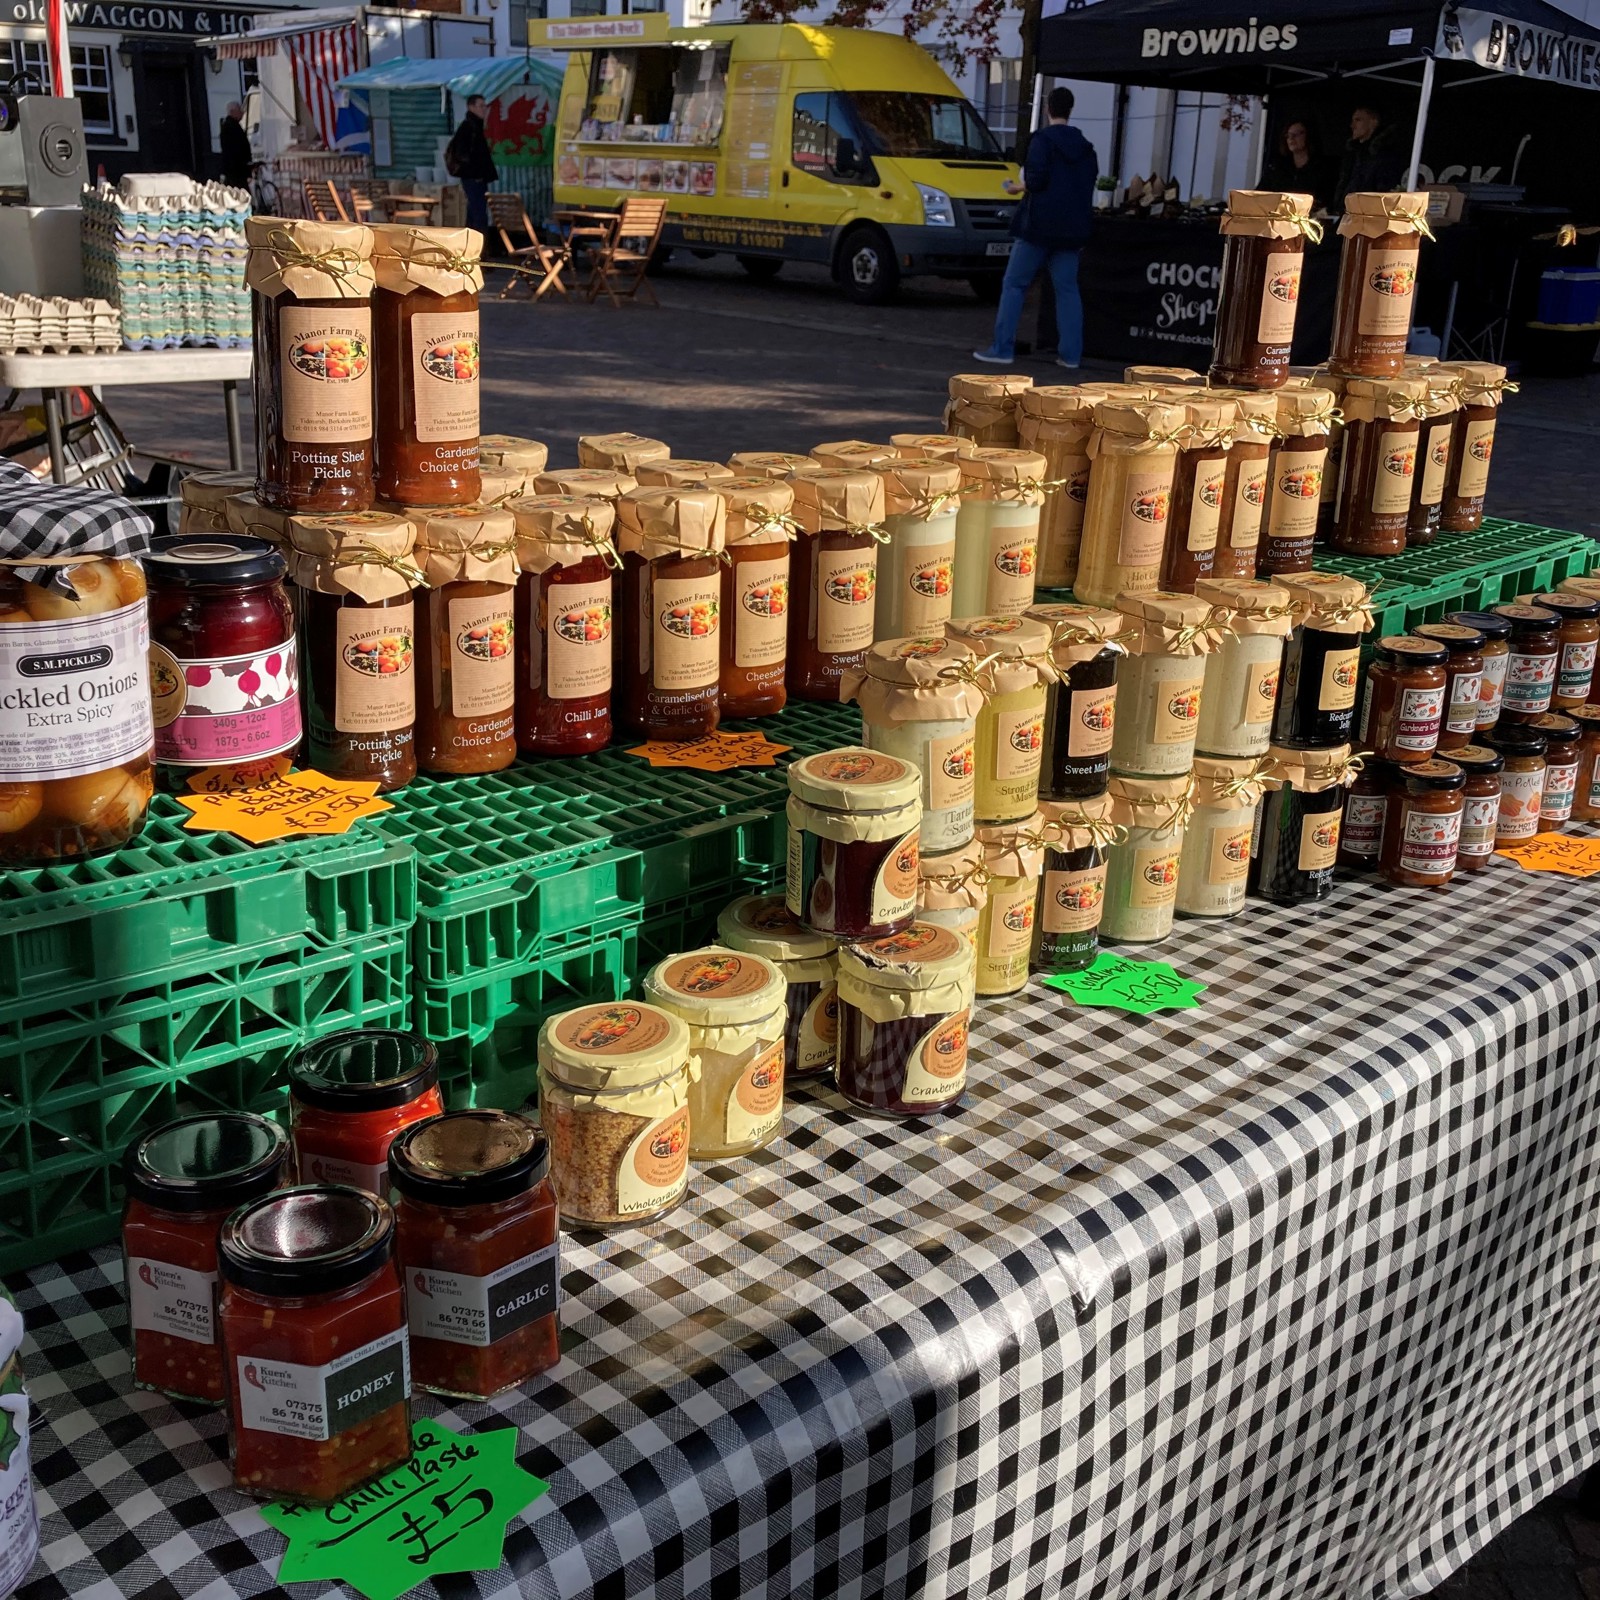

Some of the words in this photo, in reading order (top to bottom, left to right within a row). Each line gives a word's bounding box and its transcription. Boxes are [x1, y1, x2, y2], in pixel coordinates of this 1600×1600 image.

[64, 1, 184, 30] WAGGON
[195, 12, 211, 31] &
[1141, 17, 1298, 58] Brownies
[1156, 292, 1217, 328] Shop
[294, 328, 327, 343] Manor
[330, 326, 353, 337] Farm
[425, 333, 455, 348] Manor
[457, 330, 473, 339] Farm
[291, 450, 338, 465] Potting
[341, 449, 365, 463] Shed
[313, 466, 352, 479] Pickle
[419, 460, 459, 473] Choice
[1000, 540, 1022, 552] Manor
[1267, 548, 1292, 558] Onion
[829, 564, 854, 578] Manor
[855, 562, 870, 570] Farm
[915, 560, 938, 572] Manor
[747, 577, 772, 590] Manor
[773, 573, 786, 581] Farm
[558, 600, 586, 615] Manor
[588, 597, 604, 607] Farm
[665, 595, 693, 610] Manor
[694, 593, 711, 601] Farm
[461, 614, 490, 632] Manor
[492, 610, 508, 620] Farm
[349, 628, 381, 643] Manor
[383, 625, 402, 635] Farm
[33, 652, 102, 671] S.M.PICKLES
[831, 654, 860, 665] Sweet
[821, 666, 845, 676] Onio
[78, 671, 138, 702] Onions
[1172, 687, 1191, 699] Manor
[1505, 685, 1533, 698] Potting
[647, 689, 705, 704] Caramelised
[1086, 698, 1104, 709] Manor
[26, 711, 73, 728] Extra
[77, 703, 115, 723] Spicy
[564, 710, 592, 723] Chilli
[593, 706, 607, 719] Jam
[651, 705, 660, 715] &
[662, 704, 692, 716] Garlic
[213, 718, 237, 729] 340g
[245, 713, 267, 723] 12oz
[1014, 716, 1034, 730] Manor
[215, 736, 239, 748] 187g
[247, 729, 270, 742] 6.6oz
[349, 738, 392, 751] Potting
[394, 729, 413, 746] Shed
[452, 735, 492, 747] Choice
[370, 749, 403, 764] Pickle
[946, 742, 965, 758] Manor
[1064, 764, 1092, 775] Sweet
[1093, 762, 1107, 774] Mint
[238, 785, 309, 806] Baby
[1001, 781, 1030, 796] Strong
[284, 795, 371, 829] £2.50
[1404, 844, 1435, 856] Gardener's
[1060, 878, 1082, 889] Manor
[1008, 898, 1025, 911] Manor
[1041, 942, 1069, 953] Sweet
[1071, 940, 1089, 951] Mint
[988, 959, 1017, 972] Strong
[747, 1119, 774, 1138] Apple
[623, 1187, 678, 1212] Wholegrain
[153, 1267, 182, 1280] Kuen's
[428, 1275, 458, 1287] Kuen's
[154, 1275, 186, 1291] Kitchen
[429, 1284, 462, 1297] Kitchen
[176, 1298, 209, 1314] 07375
[495, 1283, 549, 1318] GARLIC
[164, 1305, 177, 1316] 86
[180, 1310, 193, 1320] 78
[196, 1314, 209, 1324] 66
[451, 1305, 485, 1318] 07375
[427, 1320, 465, 1333] Homemade
[465, 1326, 487, 1335] Malay
[438, 1313, 452, 1323] 86
[455, 1316, 469, 1326] 78
[471, 1319, 486, 1328] 66
[443, 1329, 471, 1340] Chinese
[259, 1366, 292, 1379] Kuen's
[260, 1376, 297, 1390] Kitchen
[336, 1371, 395, 1411] HONEY
[285, 1399, 323, 1413] 07375
[272, 1407, 287, 1418] 86
[290, 1410, 304, 1421] 78
[308, 1414, 324, 1424] 66
[259, 1415, 300, 1428] Homemade
[302, 1422, 325, 1432] Malay
[277, 1426, 307, 1438] Chinese
[308, 1431, 325, 1440] food
[407, 1443, 480, 1483] Paste
[387, 1474, 494, 1565] £5
